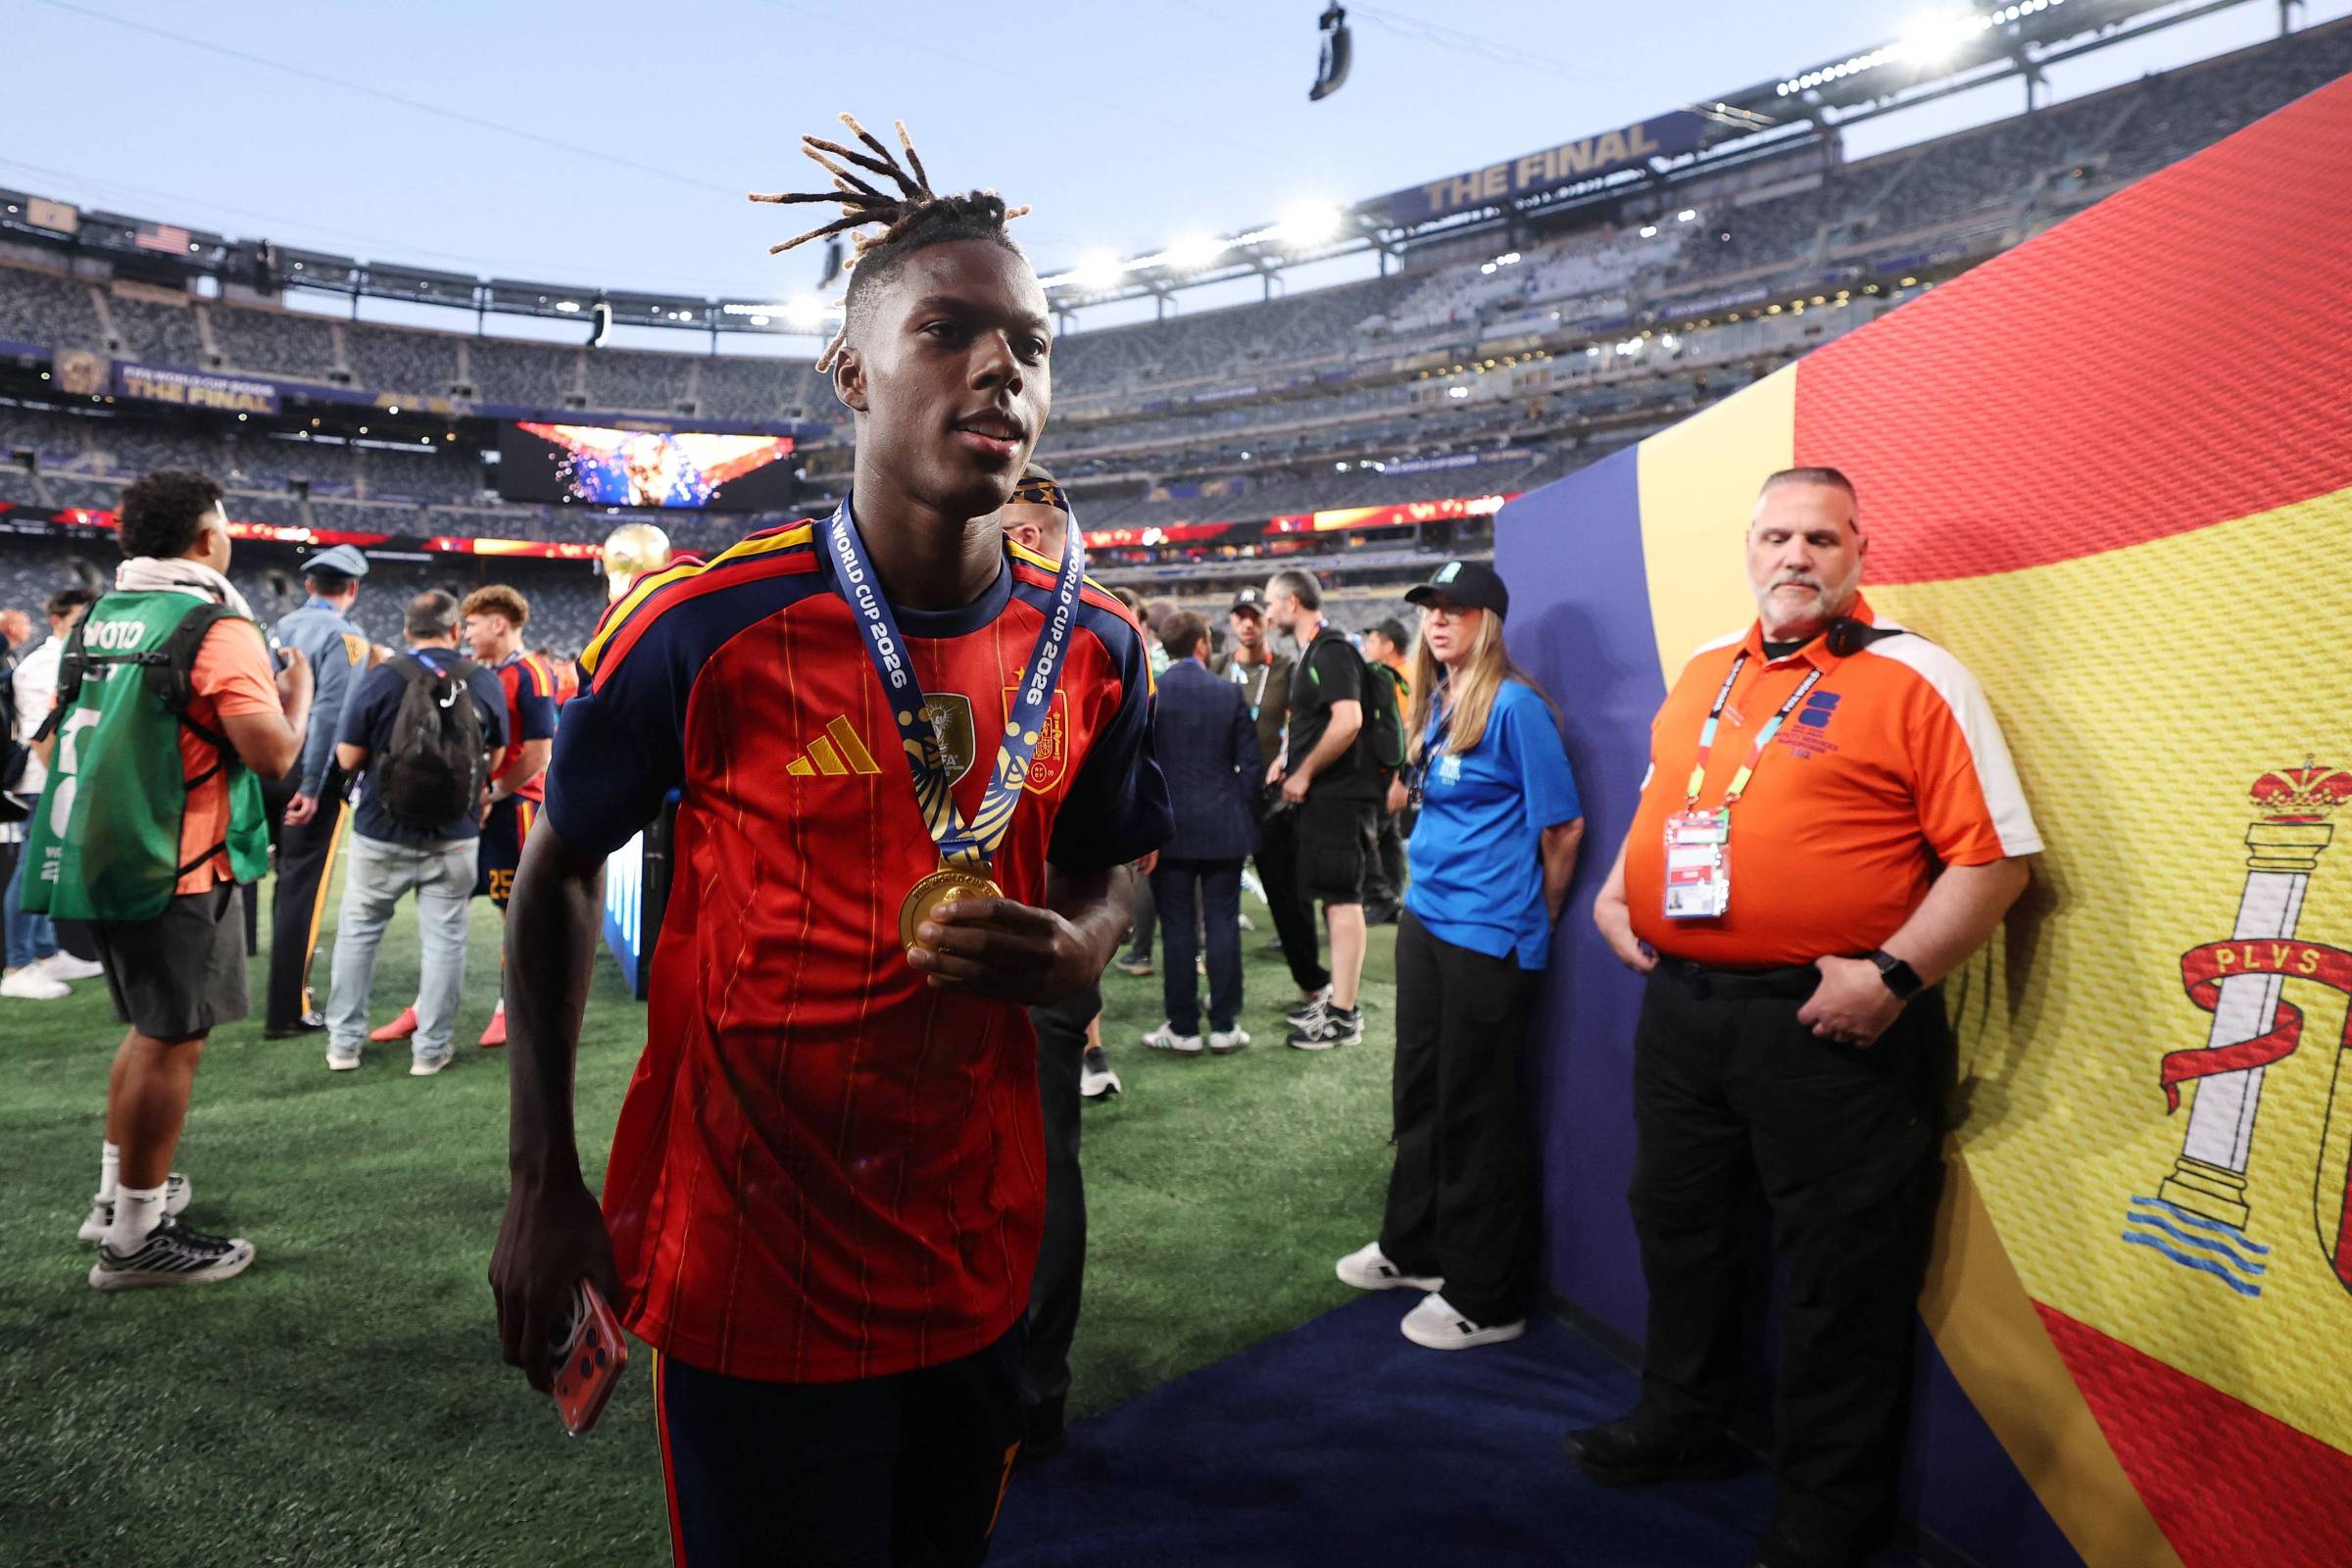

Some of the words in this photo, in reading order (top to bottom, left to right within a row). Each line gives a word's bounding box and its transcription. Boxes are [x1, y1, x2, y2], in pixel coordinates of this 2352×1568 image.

[1424, 162, 1509, 212] THE
[1515, 123, 1658, 189] FINAL
[124, 376, 185, 404] THE
[187, 386, 274, 414] FINAL
[1059, 545, 1080, 605] WORLD
[832, 521, 864, 584] WORLD
[856, 584, 881, 620] CUP
[870, 621, 907, 689] 2026
[1051, 605, 1069, 642] CUP
[1026, 641, 1058, 707] 2026
[489, 868, 515, 900] 25
[2215, 943, 2321, 974] PLVS
